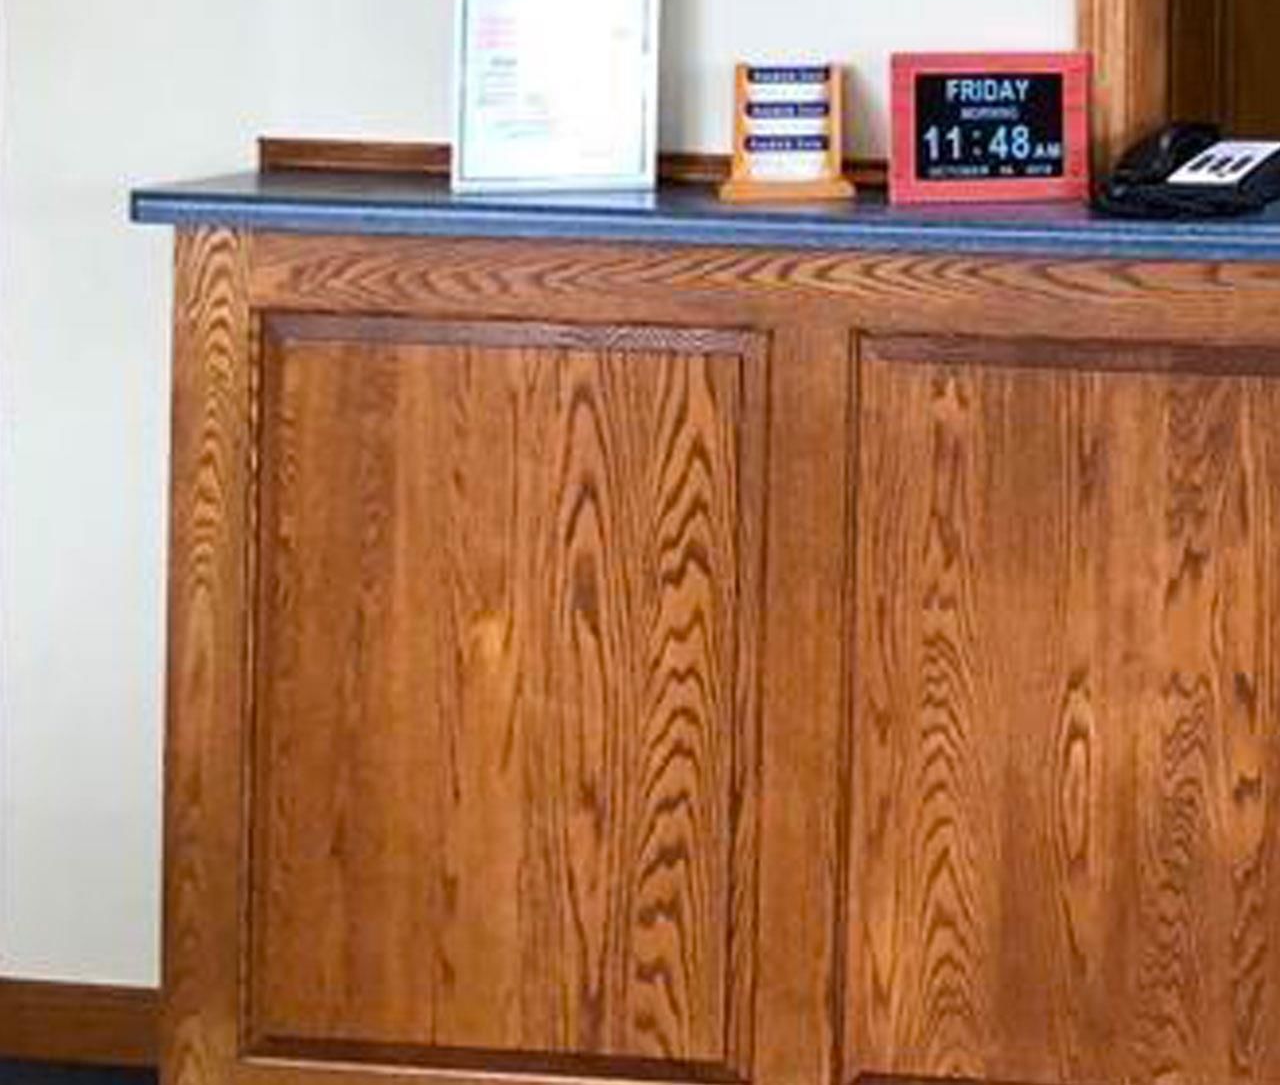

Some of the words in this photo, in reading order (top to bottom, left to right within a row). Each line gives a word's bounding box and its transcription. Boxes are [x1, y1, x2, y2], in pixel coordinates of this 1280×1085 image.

[946, 80, 1029, 102] FRIDAY
[923, 124, 1030, 160] 11:48
[1033, 143, 1061, 158] AM
